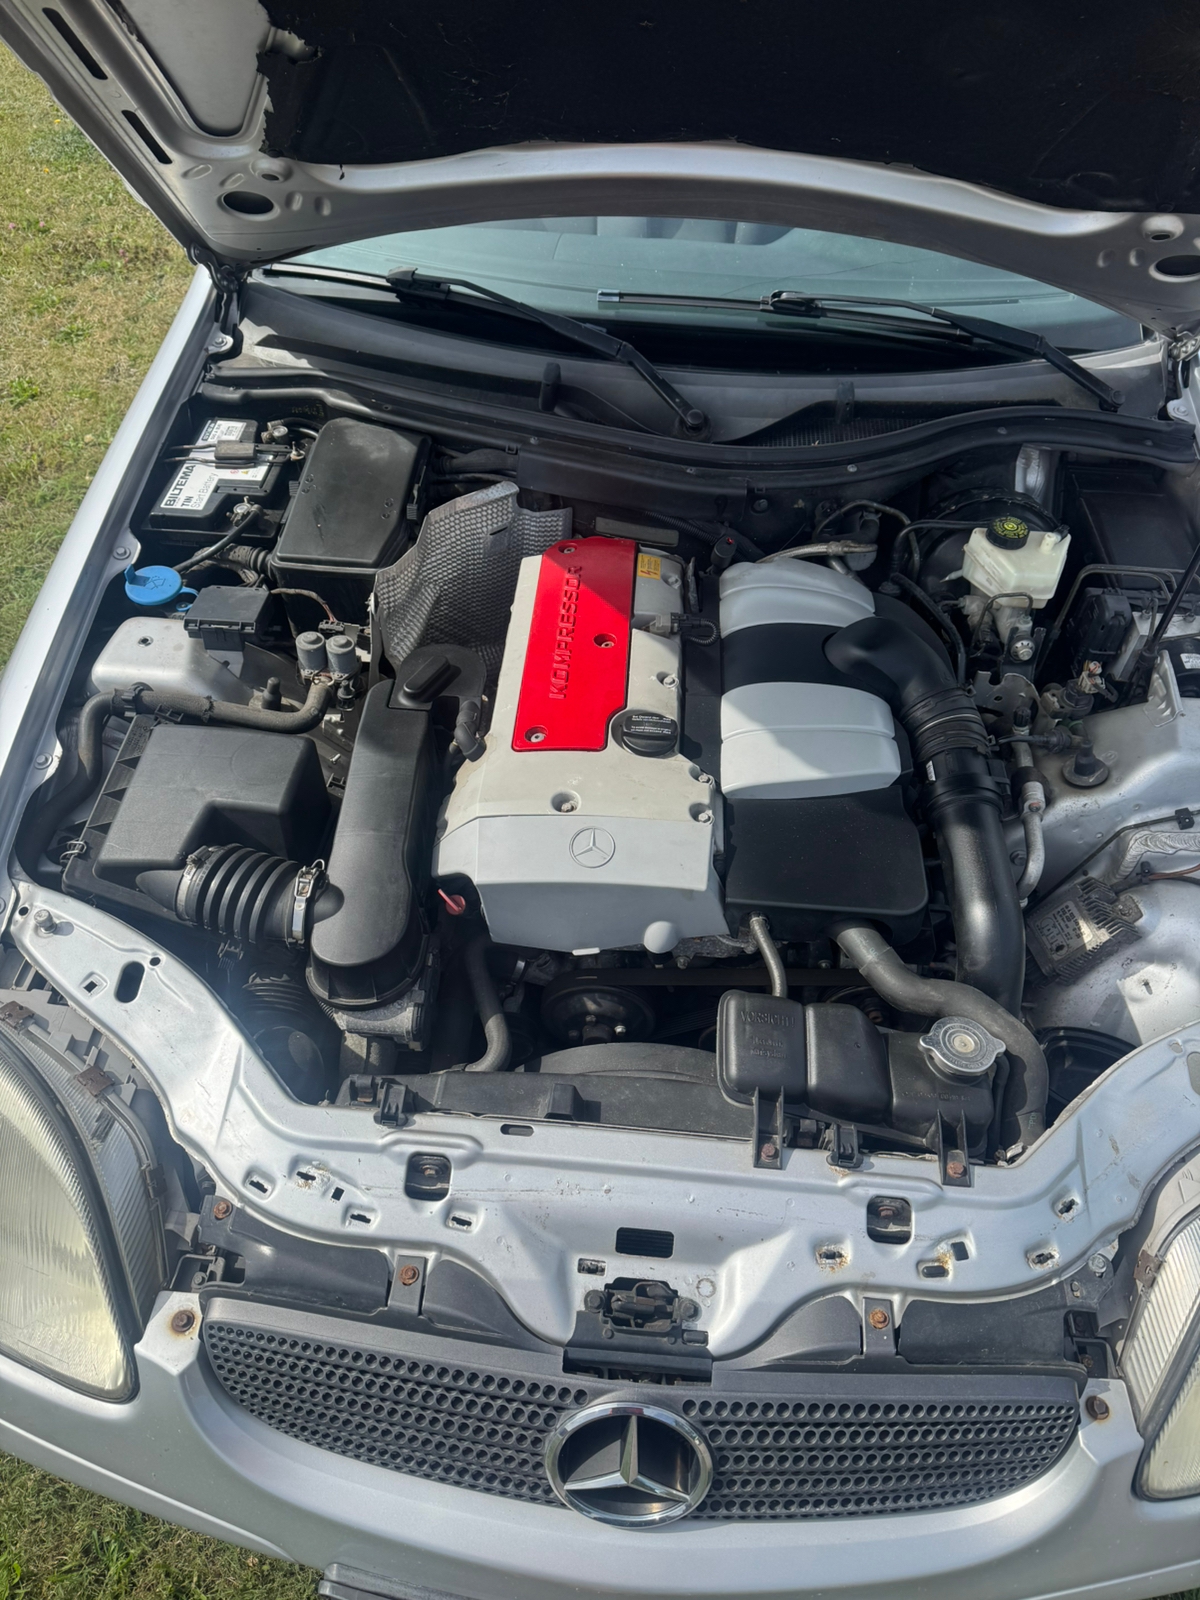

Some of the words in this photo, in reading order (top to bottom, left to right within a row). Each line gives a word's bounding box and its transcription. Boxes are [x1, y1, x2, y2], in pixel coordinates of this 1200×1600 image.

[163, 464, 197, 507] BILTEMA
[190, 492, 206, 509] Start
[198, 472, 219, 494] Battery
[549, 565, 583, 700] KOMPRESSOR
